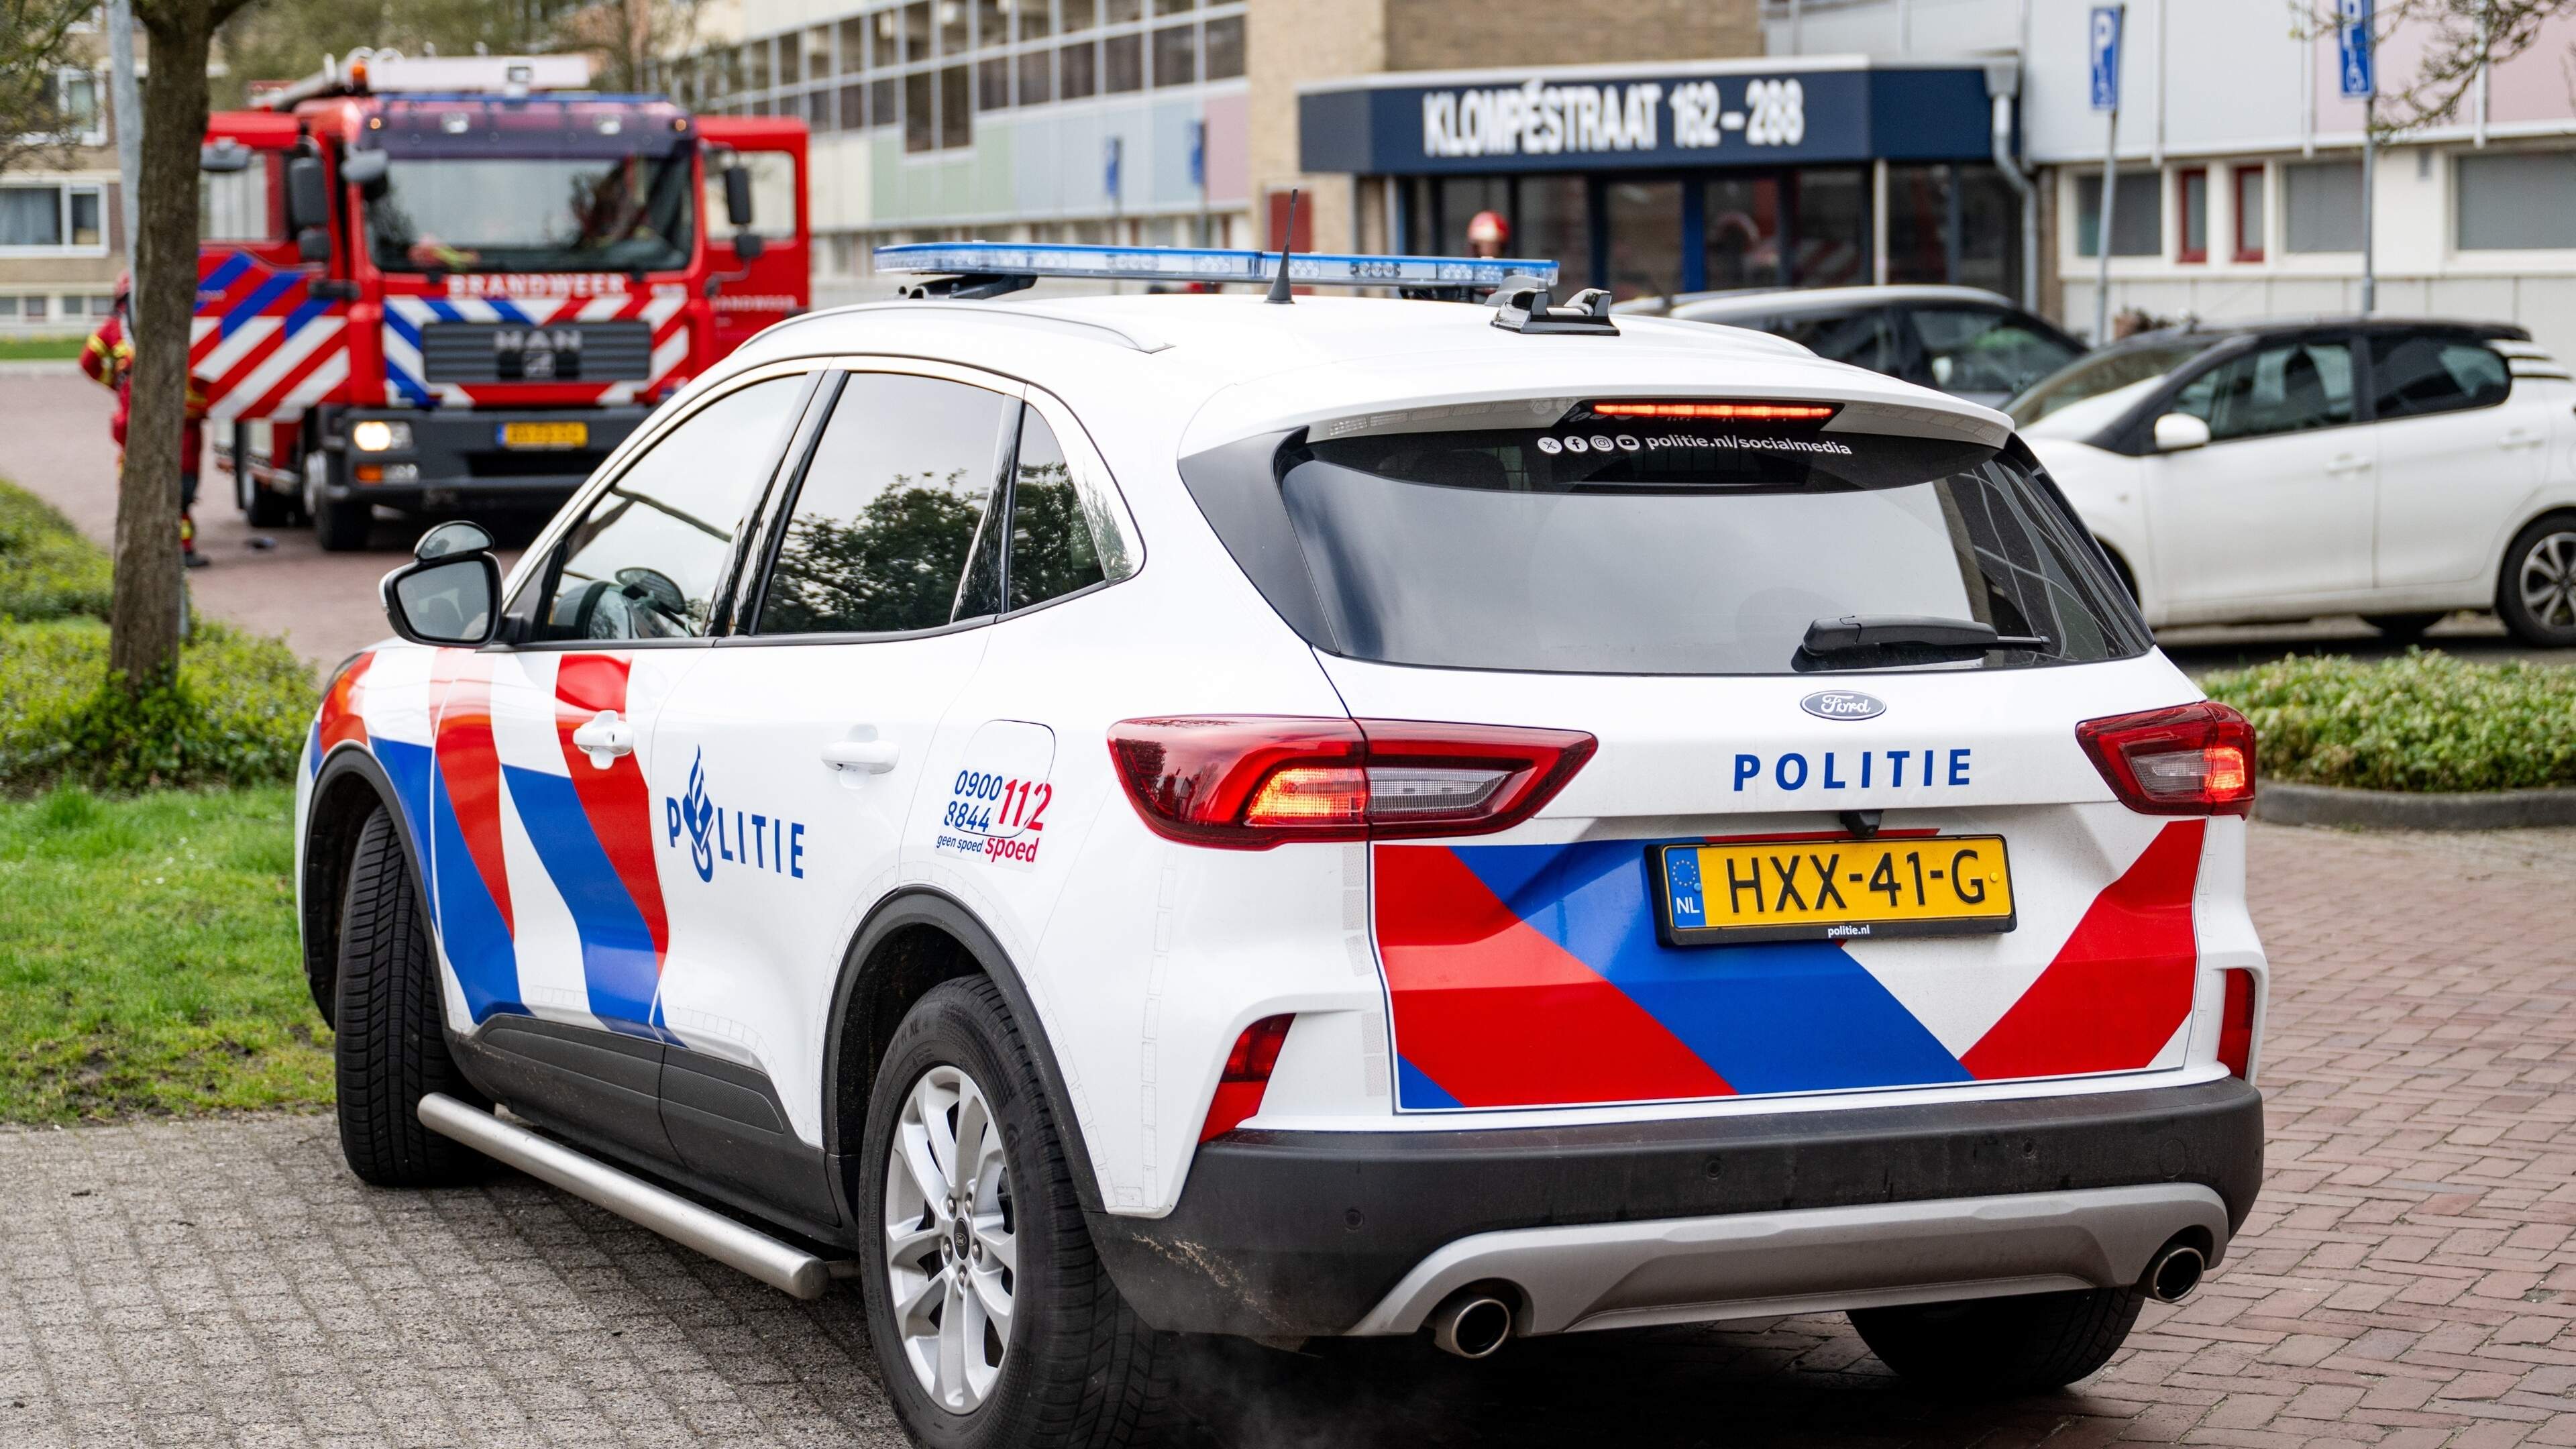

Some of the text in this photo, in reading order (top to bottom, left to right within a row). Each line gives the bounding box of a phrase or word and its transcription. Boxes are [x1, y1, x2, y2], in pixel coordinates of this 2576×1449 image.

[1423, 78, 1662, 157] KLOMPÉSTRAAT
[447, 274, 626, 294] BRANDWEER
[494, 330, 582, 352] MAN
[1645, 434, 1852, 455] politie.nl/socialmedia
[1821, 695, 1871, 713] Ford
[1733, 749, 1971, 791] POLITIE
[955, 770, 1003, 801] 0900
[944, 801, 991, 832] 8844
[998, 779, 1052, 831] 112
[665, 796, 804, 883] POLITIE
[936, 835, 983, 853] geen spoed
[985, 837, 1039, 863] spoed
[1726, 849, 1986, 914] HXX-41-G
[1676, 896, 1700, 914] NL
[1827, 924, 1870, 938] politie.nl
